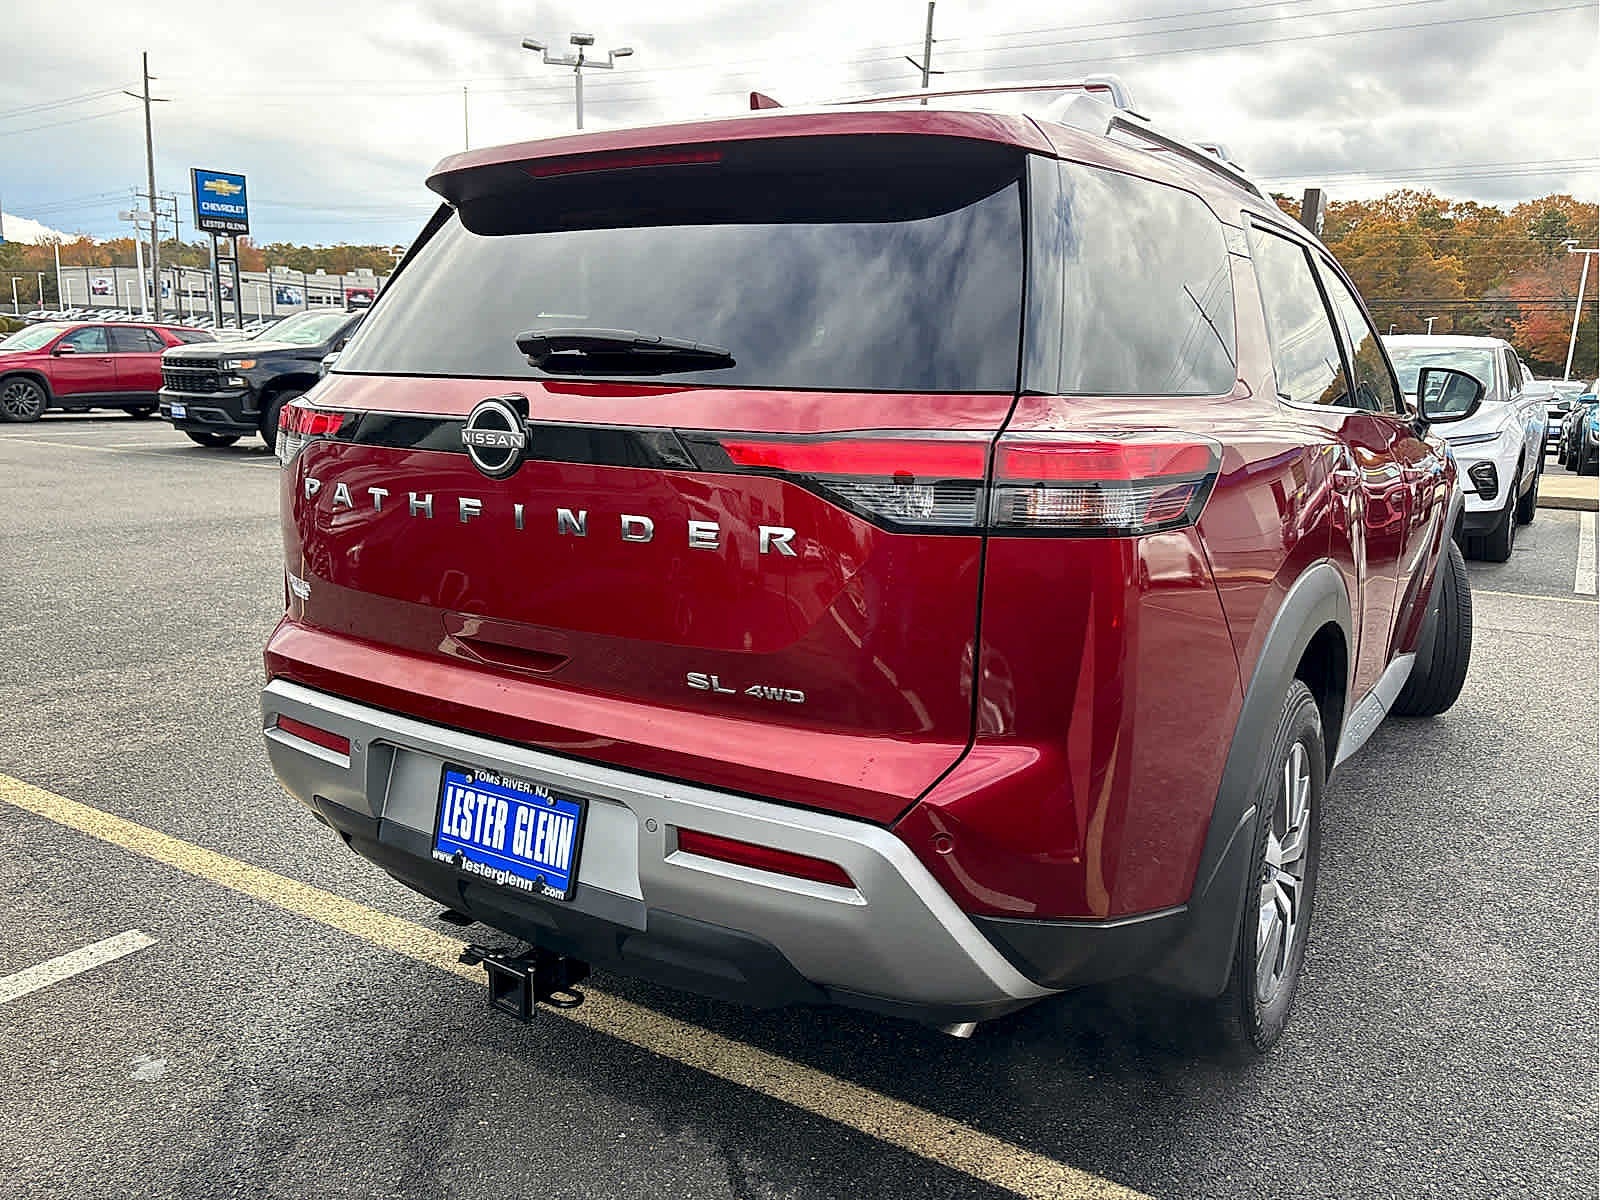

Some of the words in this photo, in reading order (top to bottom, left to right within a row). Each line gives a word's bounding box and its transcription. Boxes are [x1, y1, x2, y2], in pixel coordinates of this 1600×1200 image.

[202, 202, 245, 214] CHEVROLET
[202, 219, 225, 229] LESTER
[226, 222, 247, 231] GLENN
[462, 431, 522, 447] NISSAN
[304, 477, 798, 557] PATHFINDER
[687, 672, 736, 694] SL
[744, 685, 805, 703] 4WD
[474, 769, 501, 785] TOMS
[502, 777, 533, 794] RIVER,
[535, 785, 549, 798] NJ
[442, 786, 508, 850] LESTER
[512, 806, 574, 870] GLENN
[461, 856, 533, 892] lesterglenn
